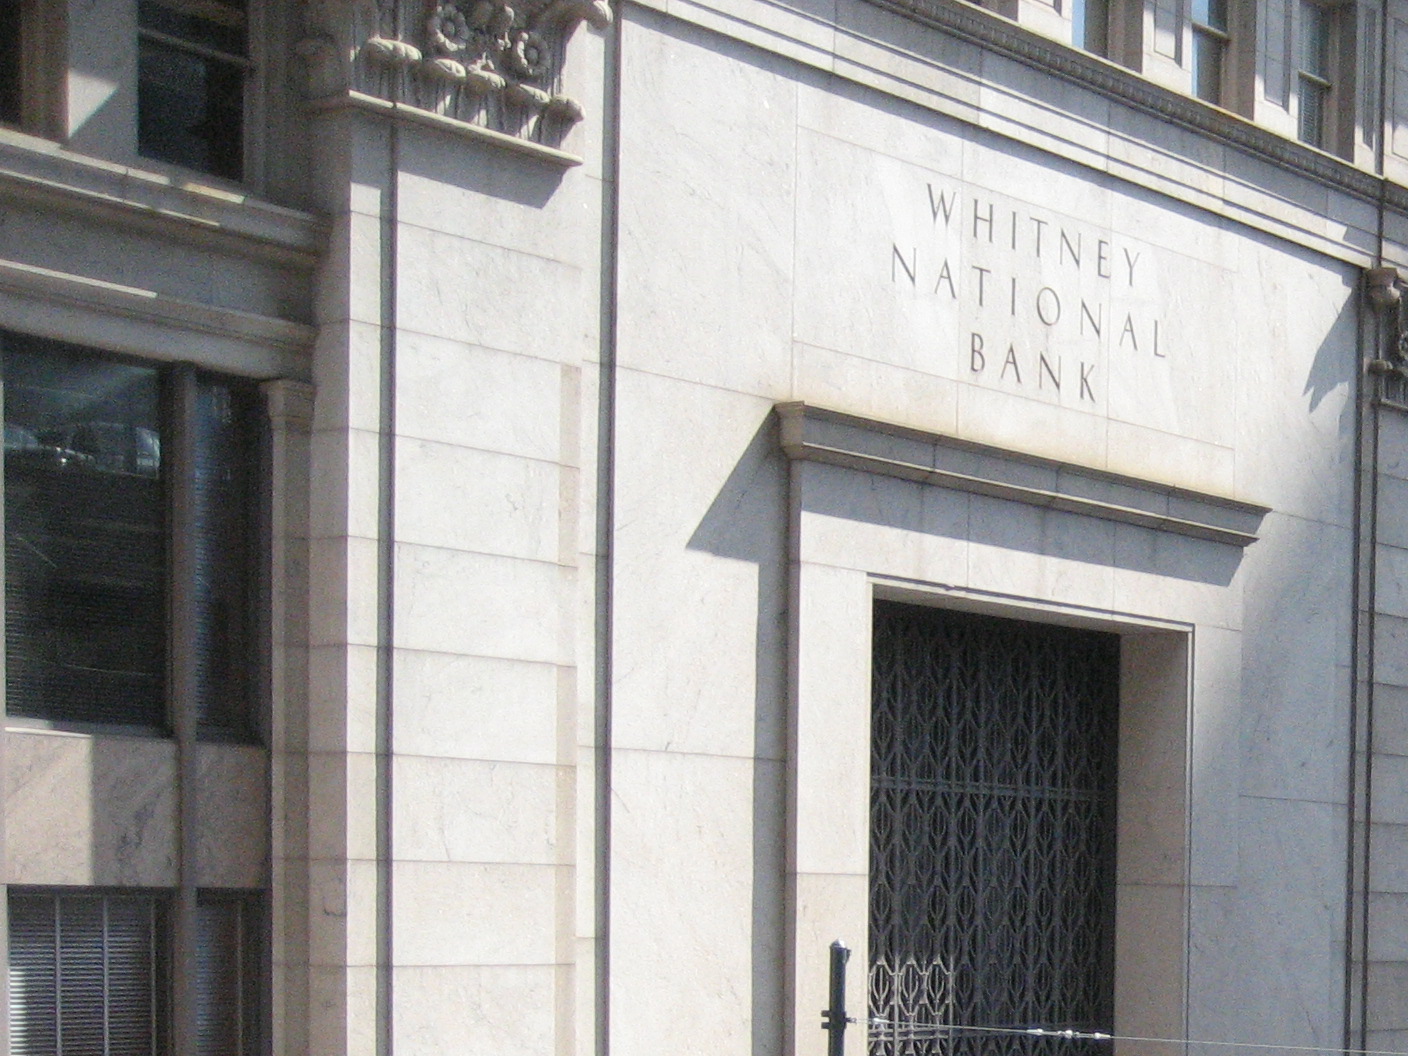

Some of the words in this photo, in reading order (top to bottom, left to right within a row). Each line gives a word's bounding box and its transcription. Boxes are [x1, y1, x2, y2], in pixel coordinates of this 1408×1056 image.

[926, 182, 1141, 288] WHITNEY
[891, 242, 1166, 358] NATIONAL
[970, 332, 1096, 404] BANK
